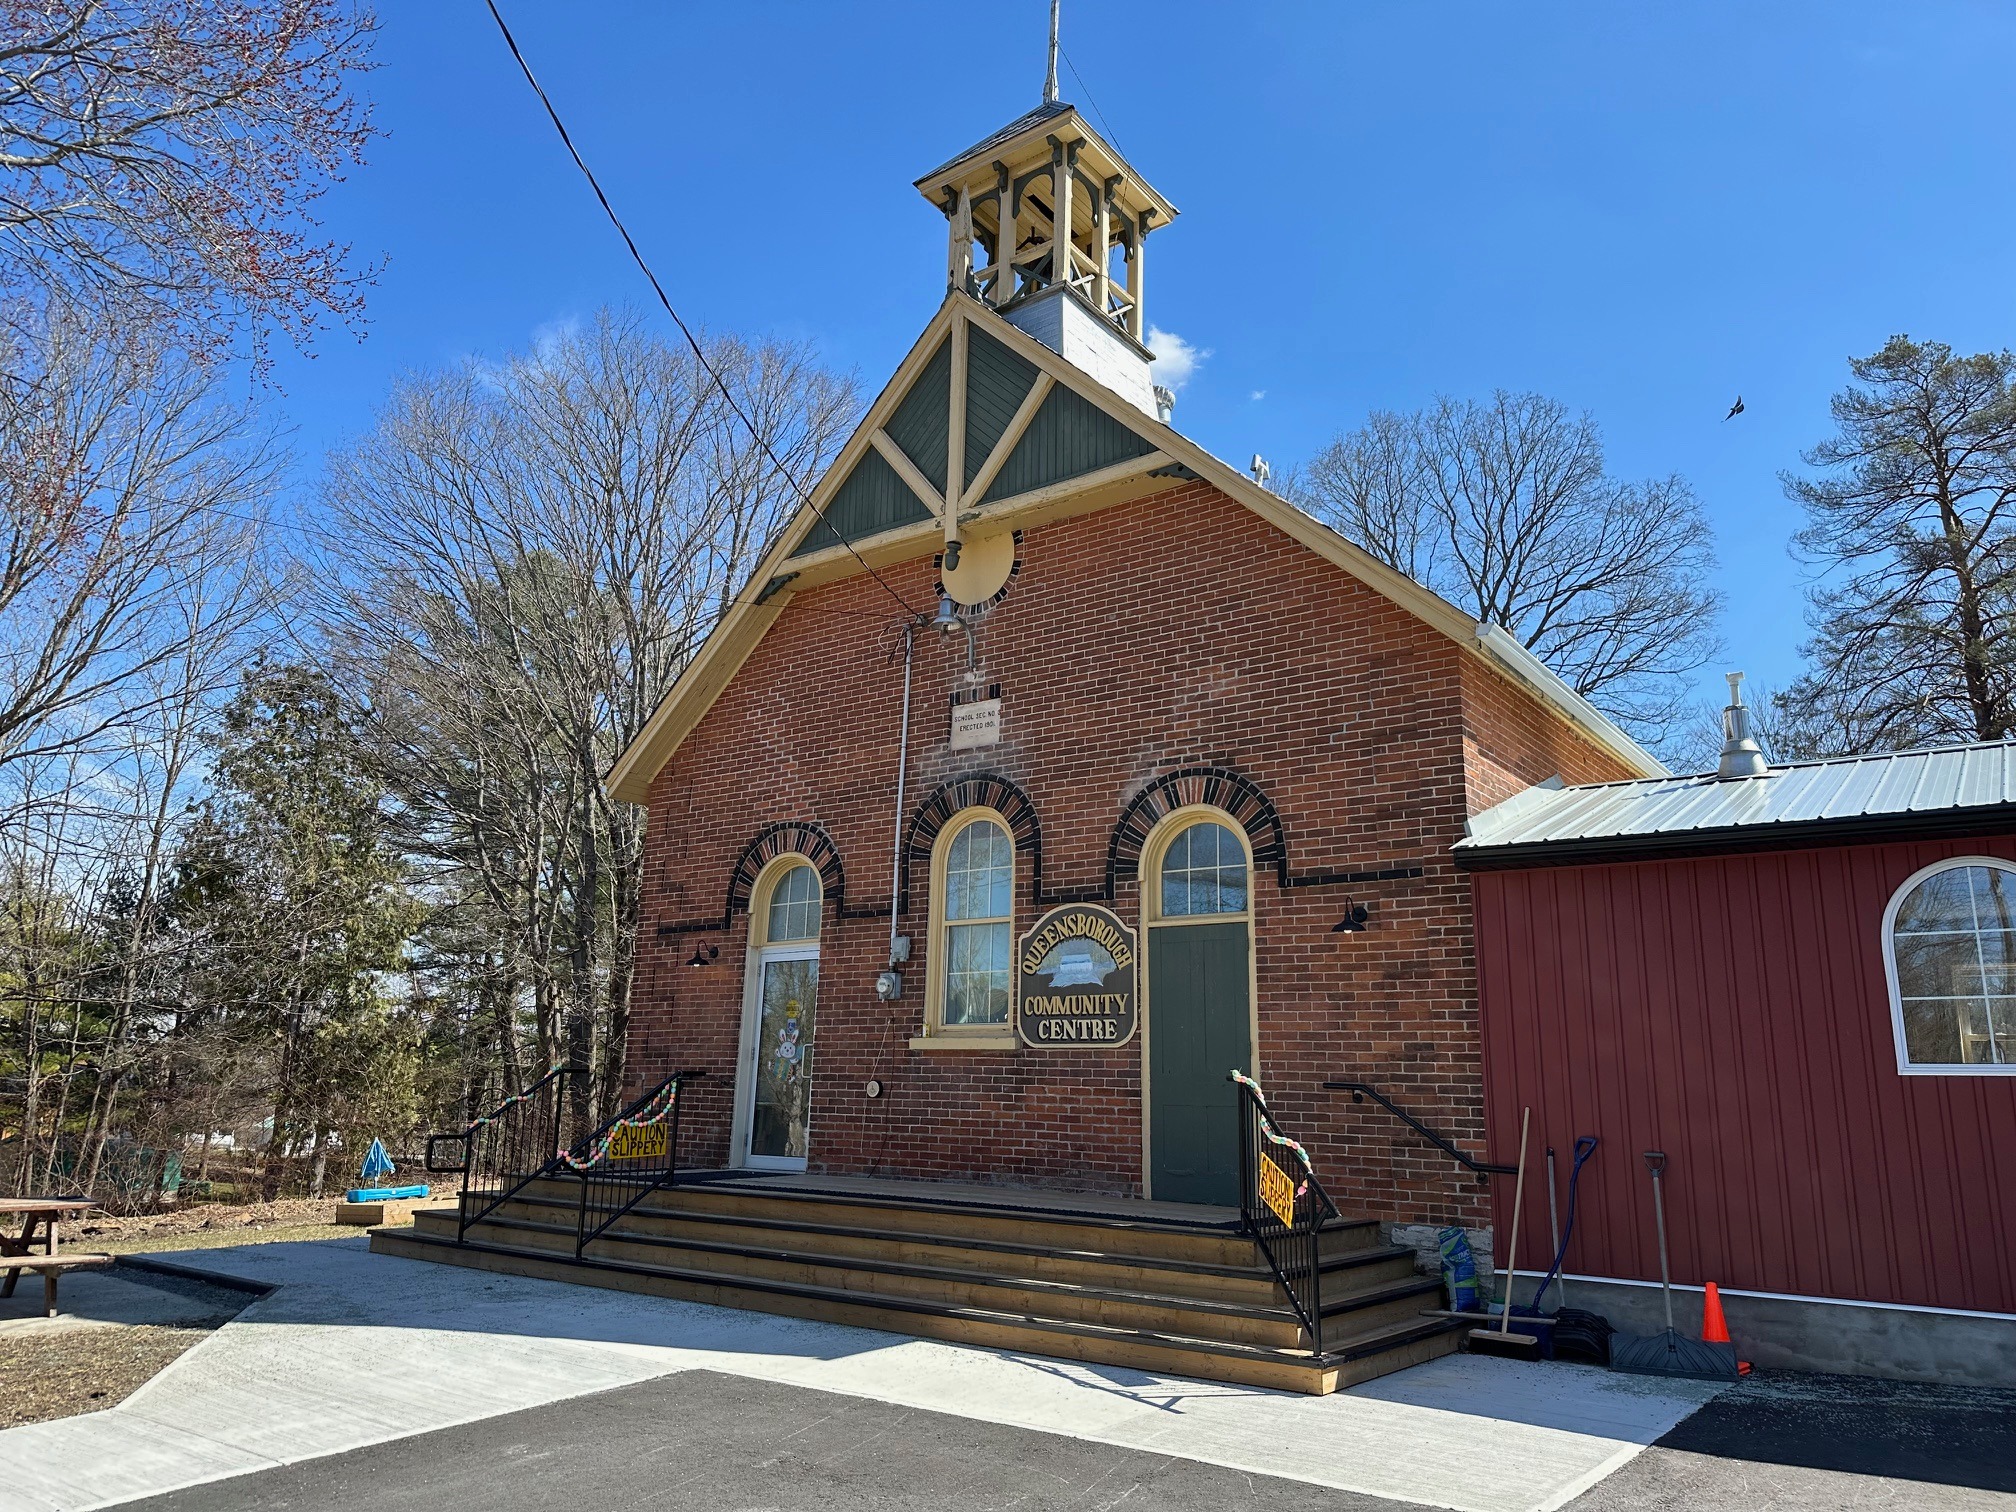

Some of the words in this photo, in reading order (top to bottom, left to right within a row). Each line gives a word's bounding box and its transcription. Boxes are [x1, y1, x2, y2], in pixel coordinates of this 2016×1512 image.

[954, 713, 974, 722] SCHOOL
[959, 722, 983, 732] ERECTED
[1022, 913, 1133, 975] QUEENSBOROUGH
[1024, 993, 1129, 1016] COMMUNITY
[1038, 1019, 1118, 1040] CENTRE
[611, 1140, 665, 1156] SLIPPERY
[1261, 1156, 1291, 1204] CAUTION
[1260, 1176, 1291, 1224] SLIPPERY
